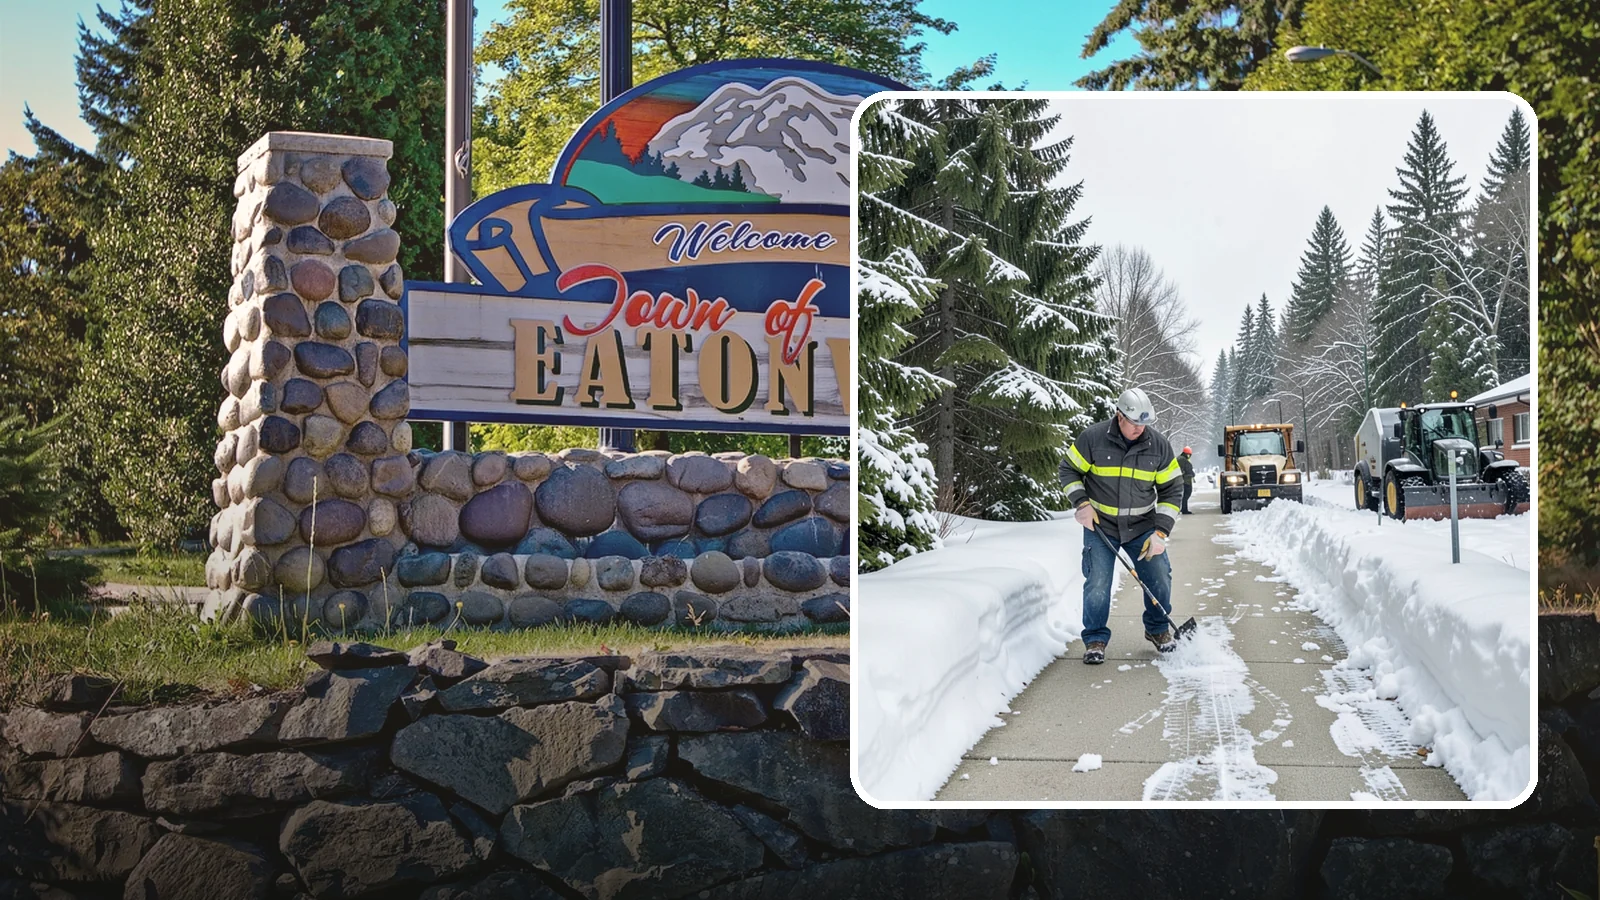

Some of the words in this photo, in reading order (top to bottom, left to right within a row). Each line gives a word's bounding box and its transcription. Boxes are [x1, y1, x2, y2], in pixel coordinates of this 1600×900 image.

[653, 221, 836, 263] Welcome
[557, 264, 735, 336] Town
[764, 279, 825, 364] of
